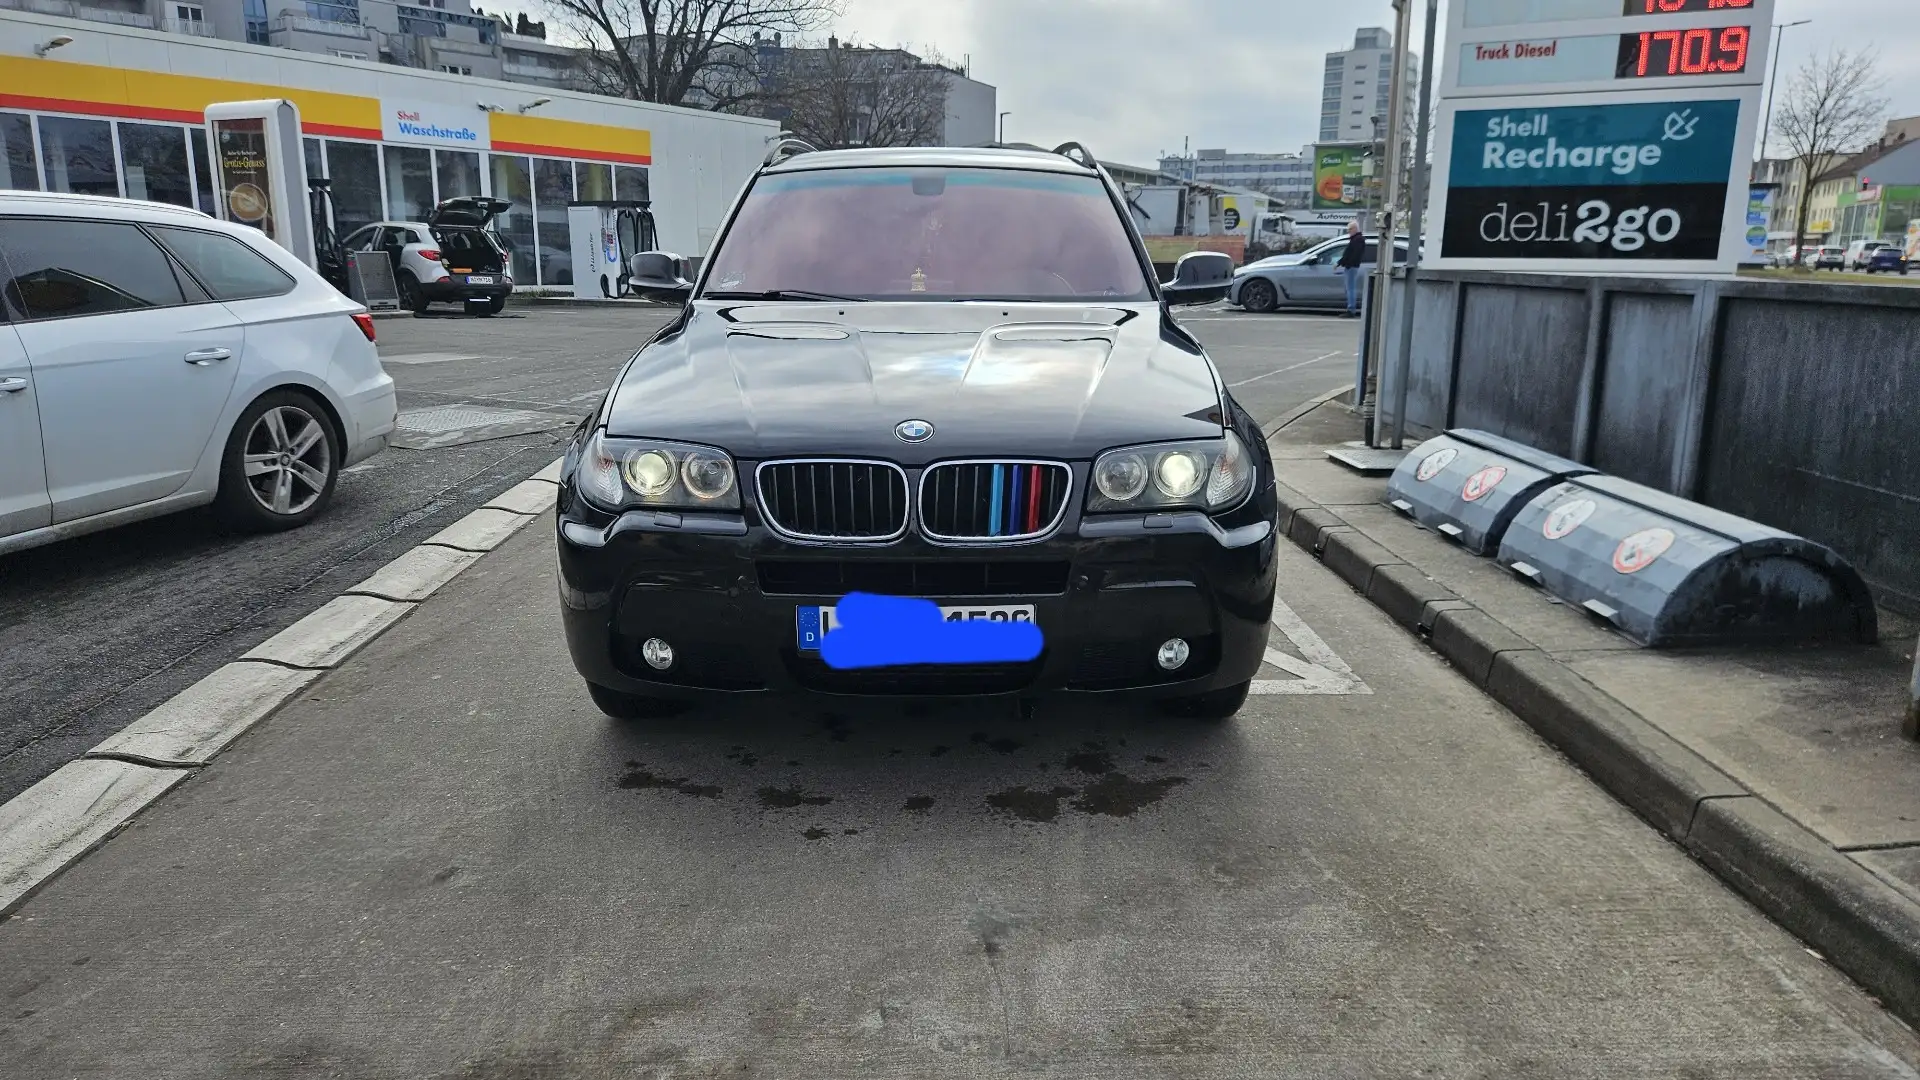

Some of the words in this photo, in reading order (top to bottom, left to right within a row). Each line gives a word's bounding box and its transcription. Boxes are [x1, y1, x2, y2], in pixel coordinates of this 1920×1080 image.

[1475, 43, 1510, 60] Truck
[1515, 40, 1557, 59] Diesel
[1636, 25, 1749, 76] 170.9
[397, 110, 420, 121] Shell
[1486, 114, 1548, 138] Shell
[398, 122, 476, 140] Waschstraße
[1482, 137, 1662, 175] Recharge
[1479, 200, 1681, 251] deli2go
[806, 632, 814, 642] D
